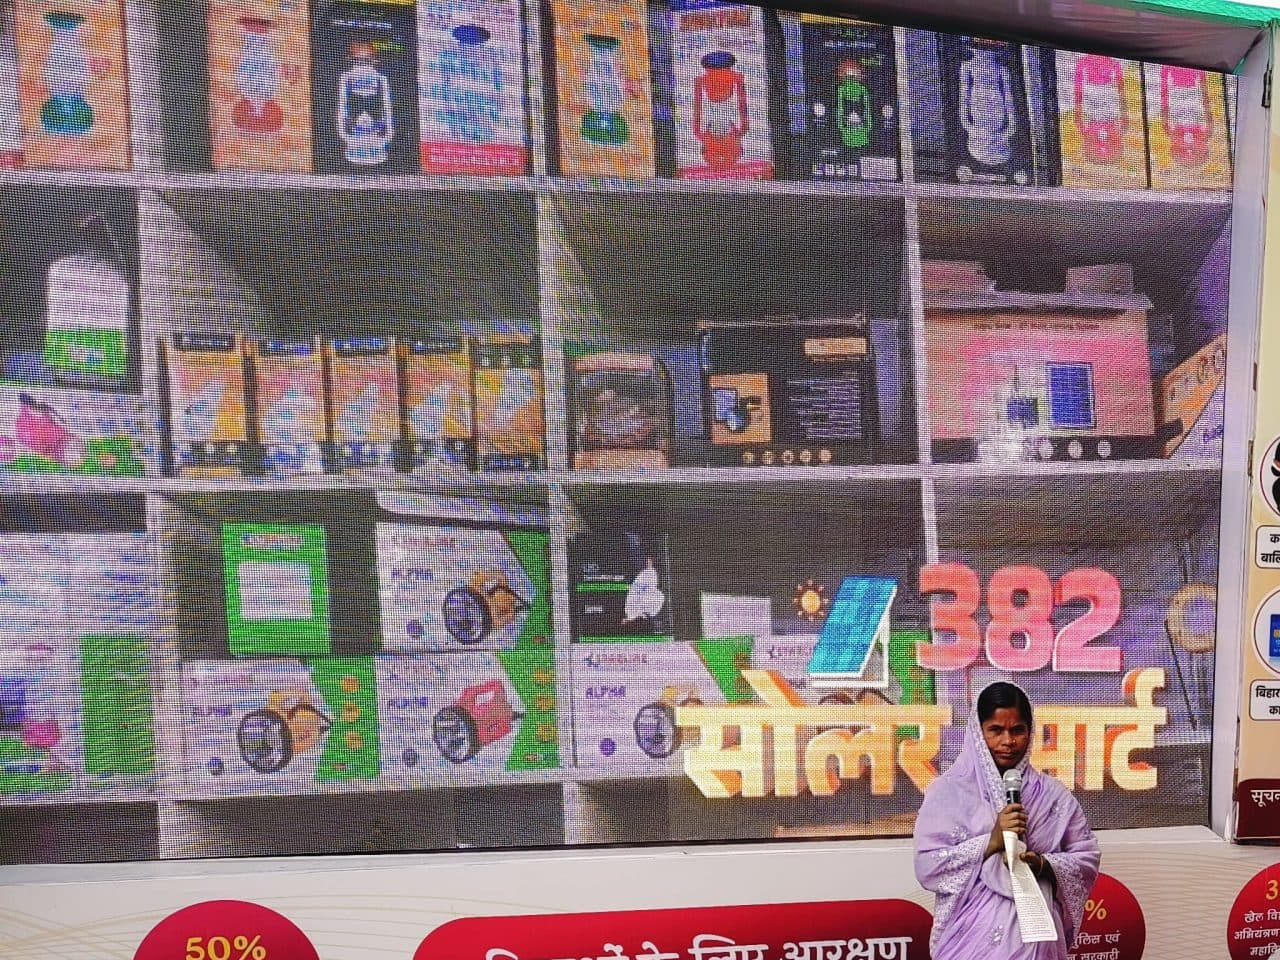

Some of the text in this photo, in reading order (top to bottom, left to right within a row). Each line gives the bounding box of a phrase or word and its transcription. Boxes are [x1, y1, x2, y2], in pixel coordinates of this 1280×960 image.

[916, 560, 1123, 672] 382
[1255, 686, 1280, 699] बिहार
[675, 668, 953, 800] सोलर
[1244, 911, 1264, 924] खेल
[1072, 930, 1121, 949] ुलिस एवं
[1234, 927, 1279, 941] अभियंत्रण
